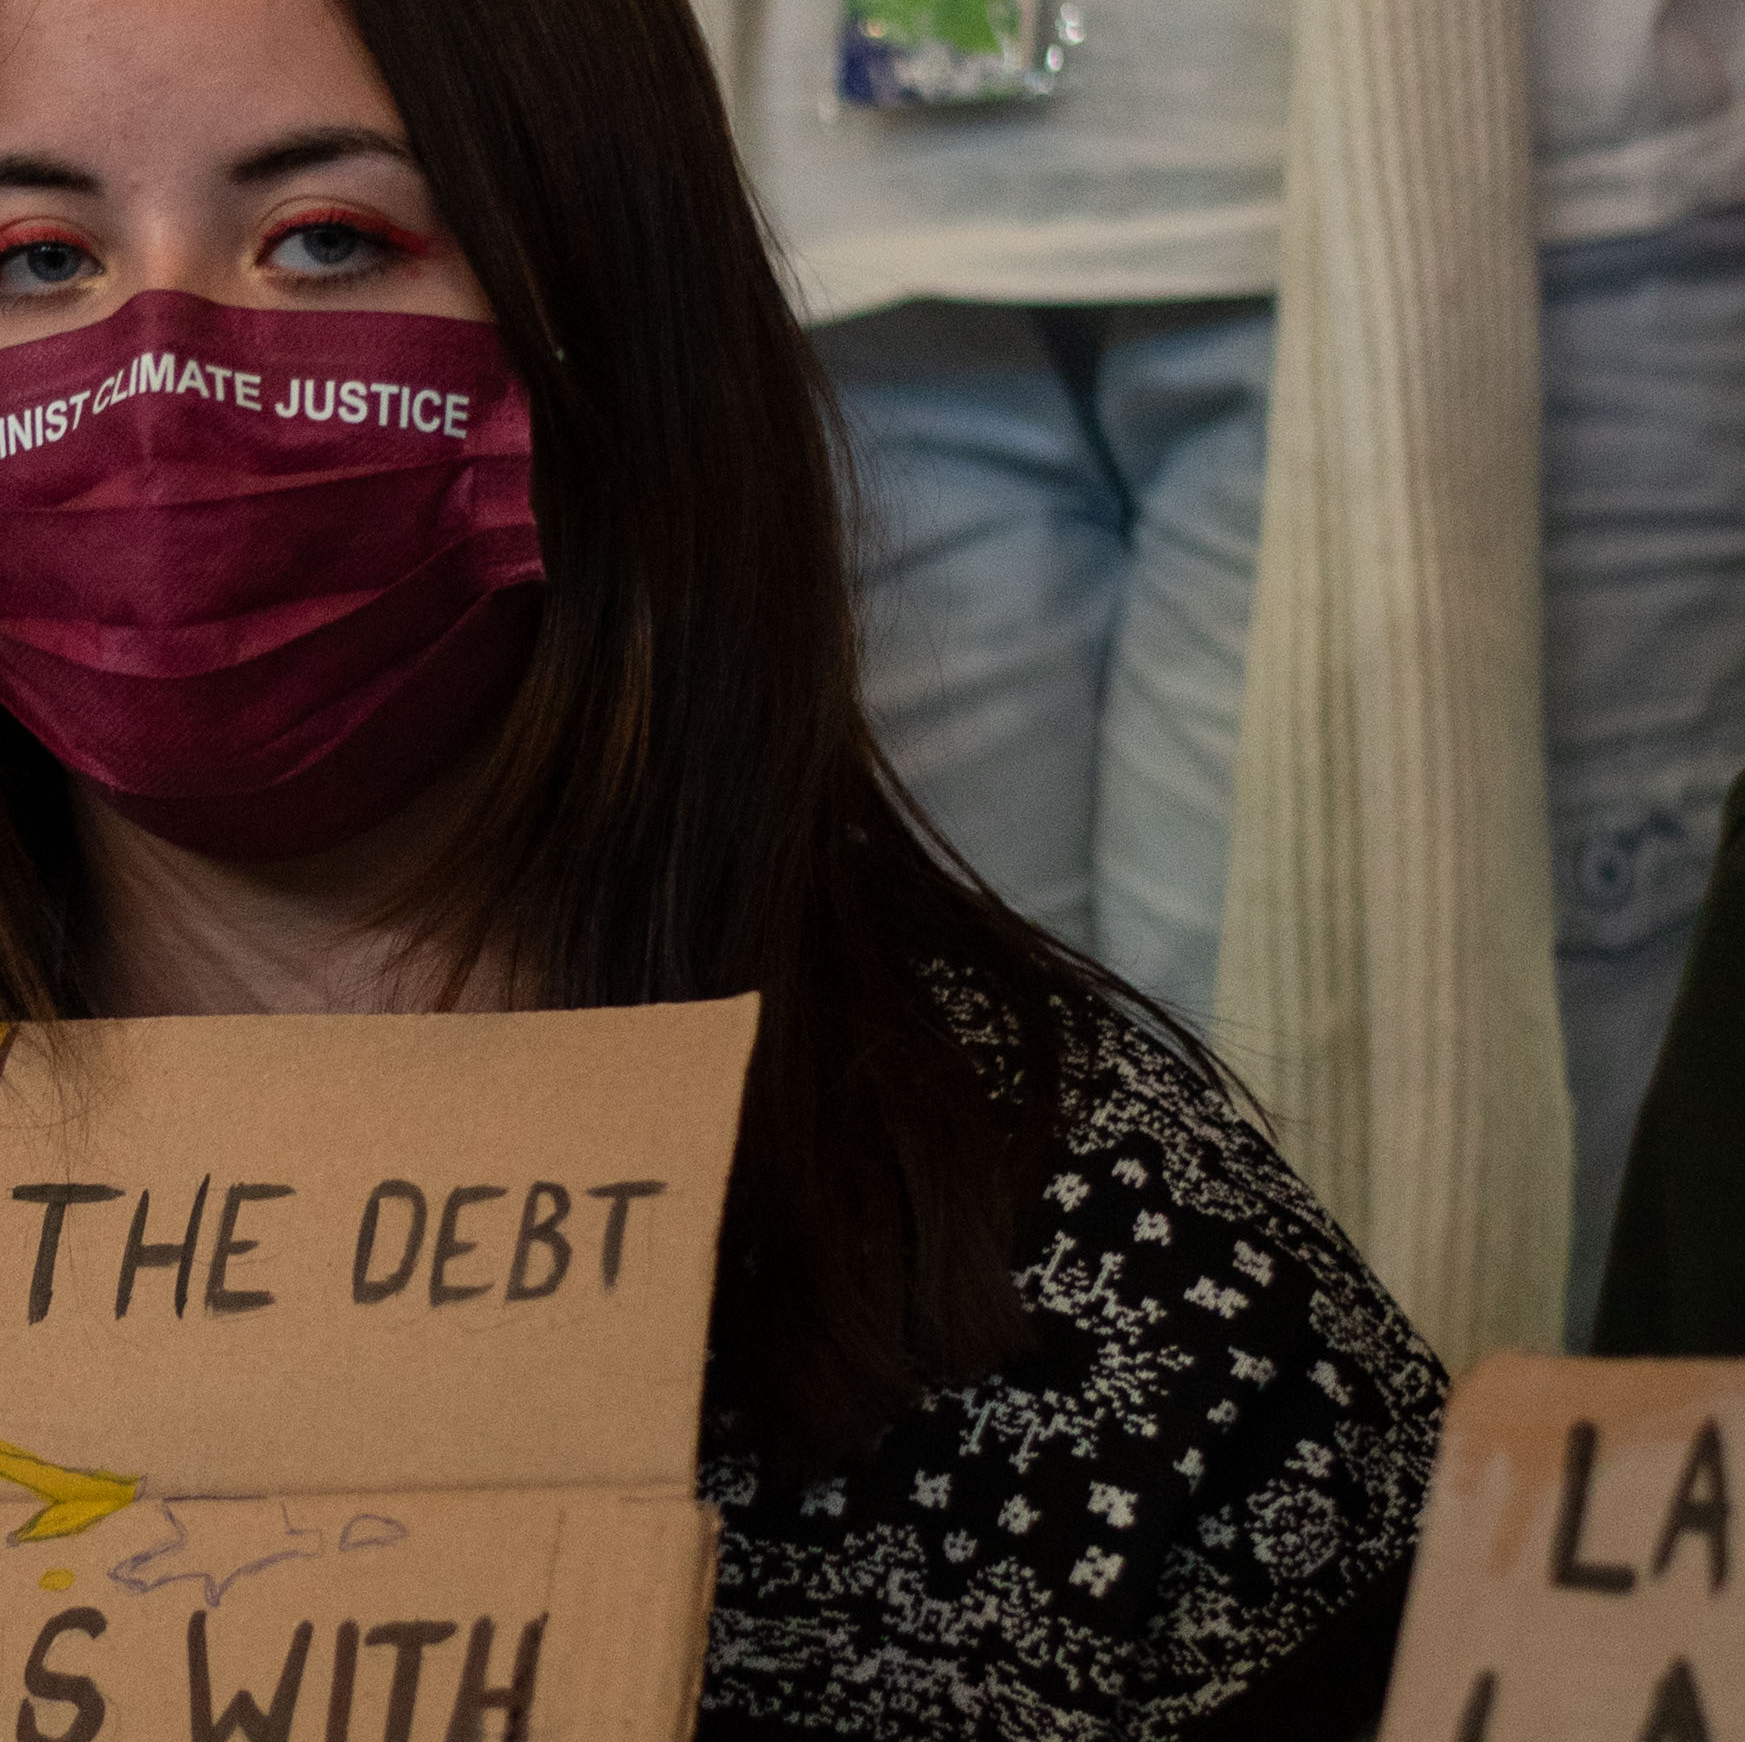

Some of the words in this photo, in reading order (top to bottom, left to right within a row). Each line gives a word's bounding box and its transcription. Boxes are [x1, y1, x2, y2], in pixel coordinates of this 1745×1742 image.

[90, 351, 262, 422] CLIMATE
[274, 378, 470, 440] JUSTICE
[11, 1173, 296, 1327] THE
[351, 1179, 669, 1309] DEBT
